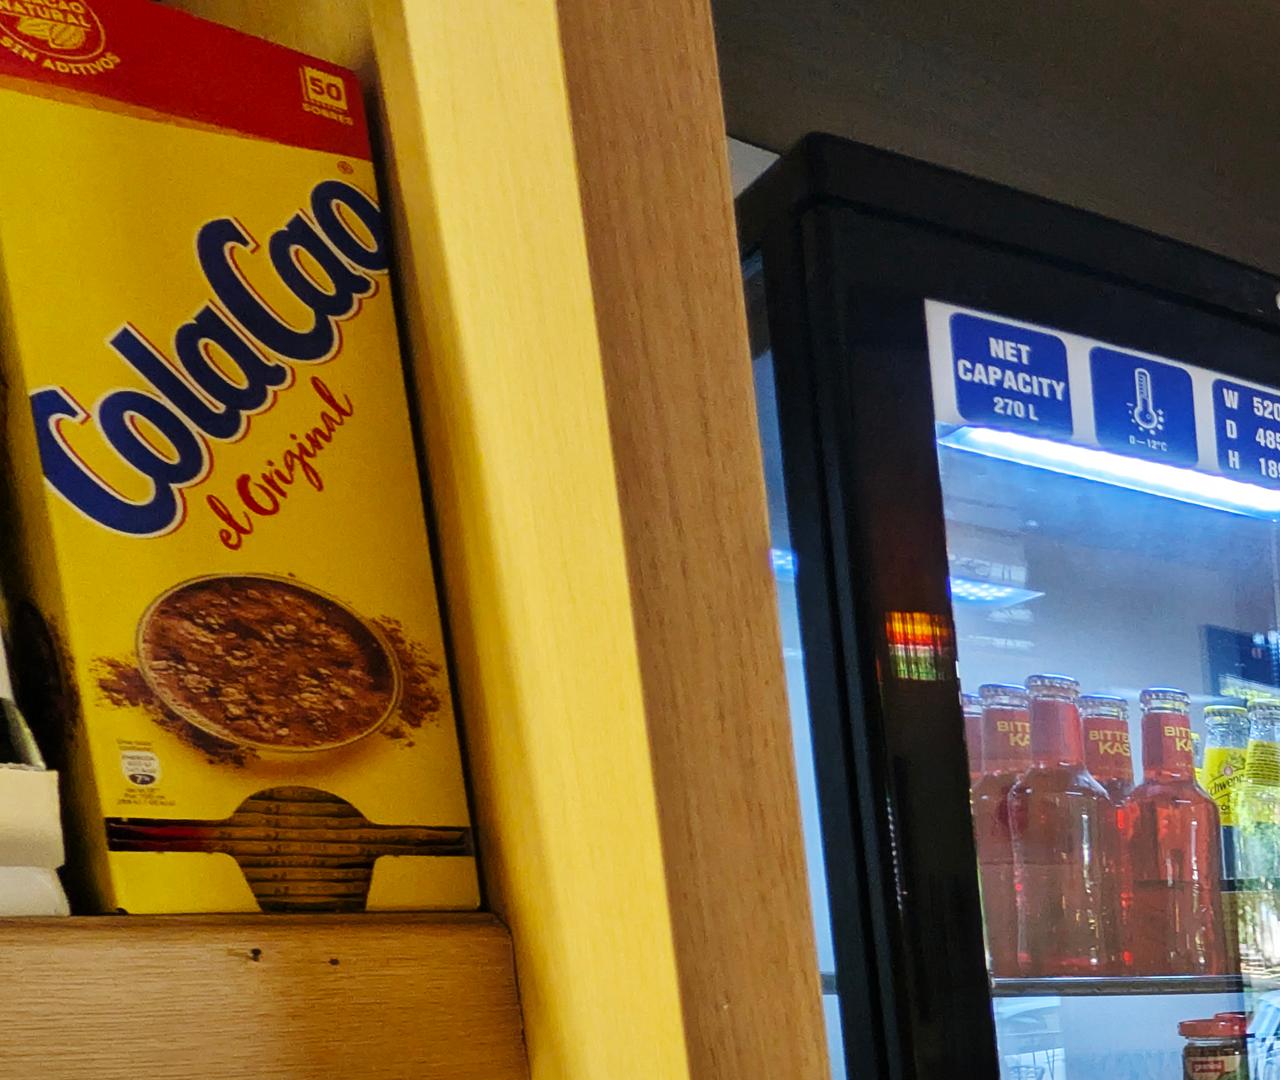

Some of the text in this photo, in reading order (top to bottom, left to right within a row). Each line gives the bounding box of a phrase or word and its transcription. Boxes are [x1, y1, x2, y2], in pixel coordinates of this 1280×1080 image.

[309, 76, 342, 101] 50
[28, 178, 390, 540] ColaCao
[988, 336, 1031, 366] NET
[957, 358, 1066, 401] CAPACITY
[993, 396, 1039, 421] 270 L
[1222, 388, 1239, 411] W
[1225, 419, 1238, 440] D
[206, 375, 355, 552] el Original
[1228, 450, 1240, 470] H
[1089, 729, 1129, 743] BITTE
